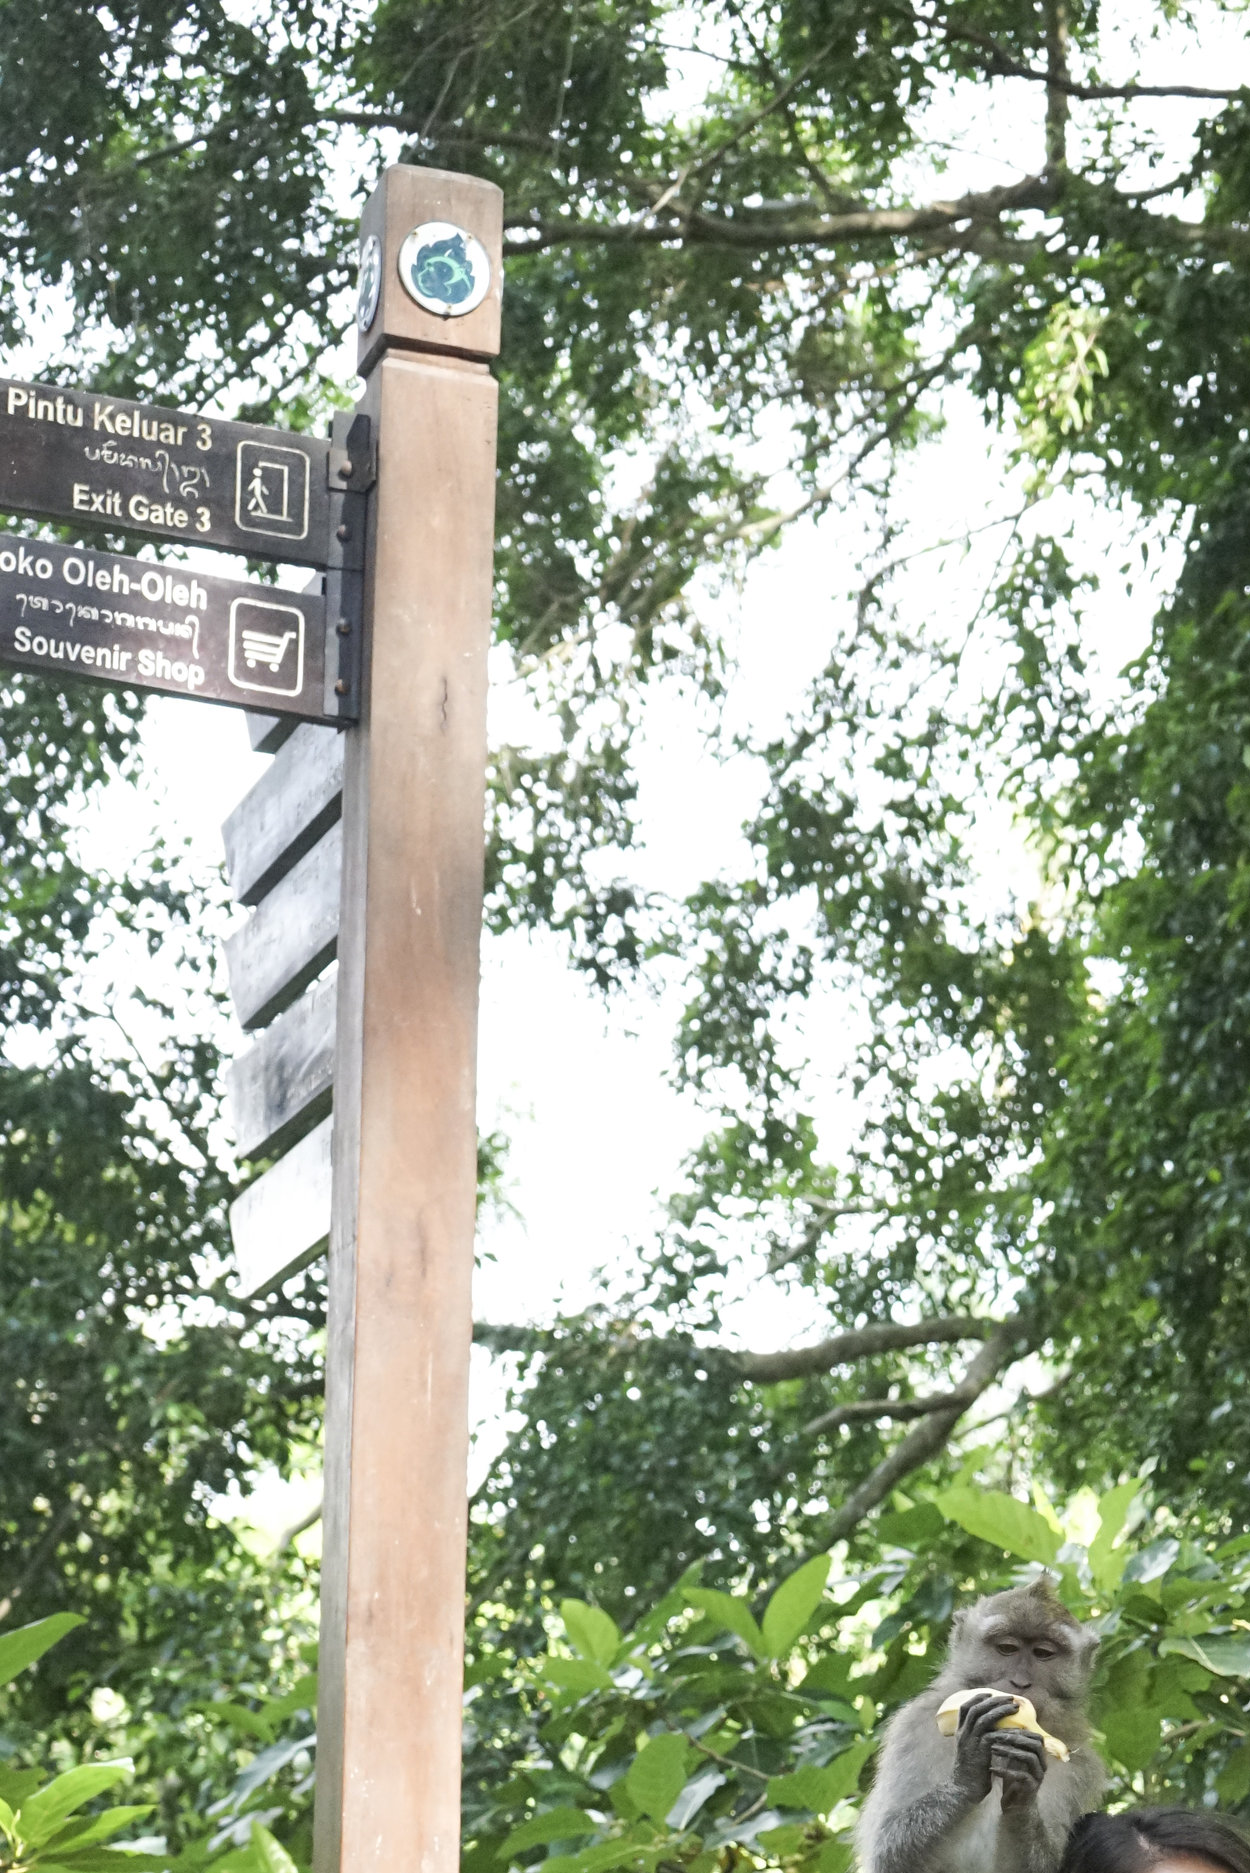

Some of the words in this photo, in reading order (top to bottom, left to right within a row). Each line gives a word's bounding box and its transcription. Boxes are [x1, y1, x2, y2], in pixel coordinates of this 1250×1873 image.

[7, 386, 84, 427] Pintu
[93, 402, 189, 446] Keluar
[196, 423, 213, 451] 3
[72, 483, 123, 517] Exit
[128, 494, 189, 528] Gate
[195, 506, 212, 532] 3
[0, 546, 54, 580] oko
[62, 556, 208, 610] Oleh-Oleh
[14, 626, 133, 672] Souvenir
[136, 649, 206, 691] Shop
